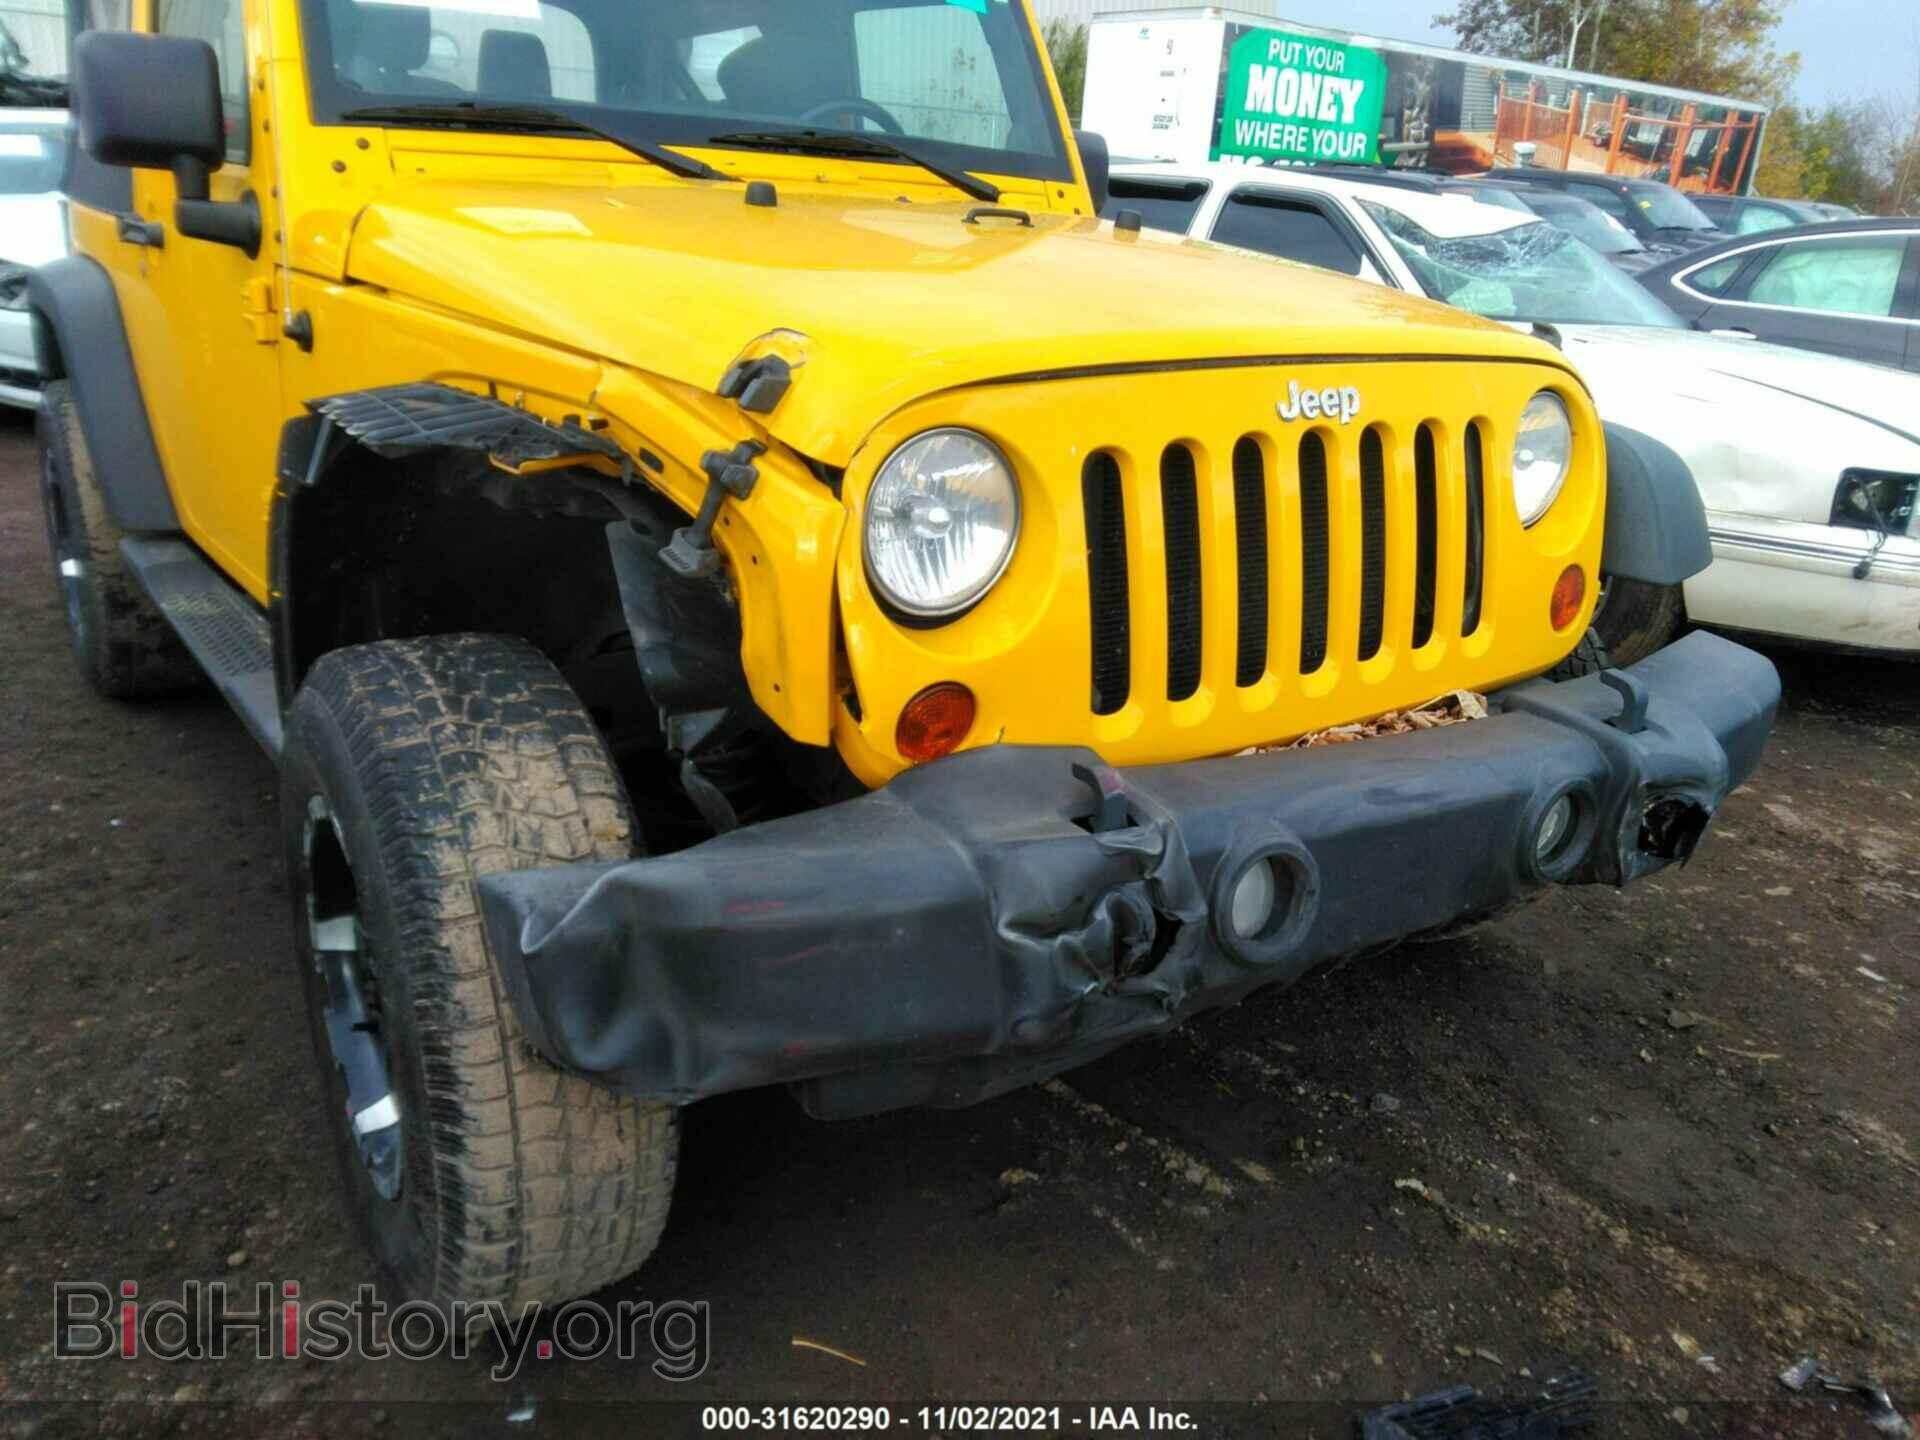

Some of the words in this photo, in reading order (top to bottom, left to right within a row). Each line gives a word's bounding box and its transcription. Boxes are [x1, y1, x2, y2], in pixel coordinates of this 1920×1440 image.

[1267, 38, 1303, 66] PUT
[1304, 45, 1345, 74] YOUR
[1244, 63, 1365, 125] MONEY
[1235, 118, 1310, 153] WHERE
[1312, 127, 1368, 159] YOUR
[1276, 379, 1361, 425] Jeep
